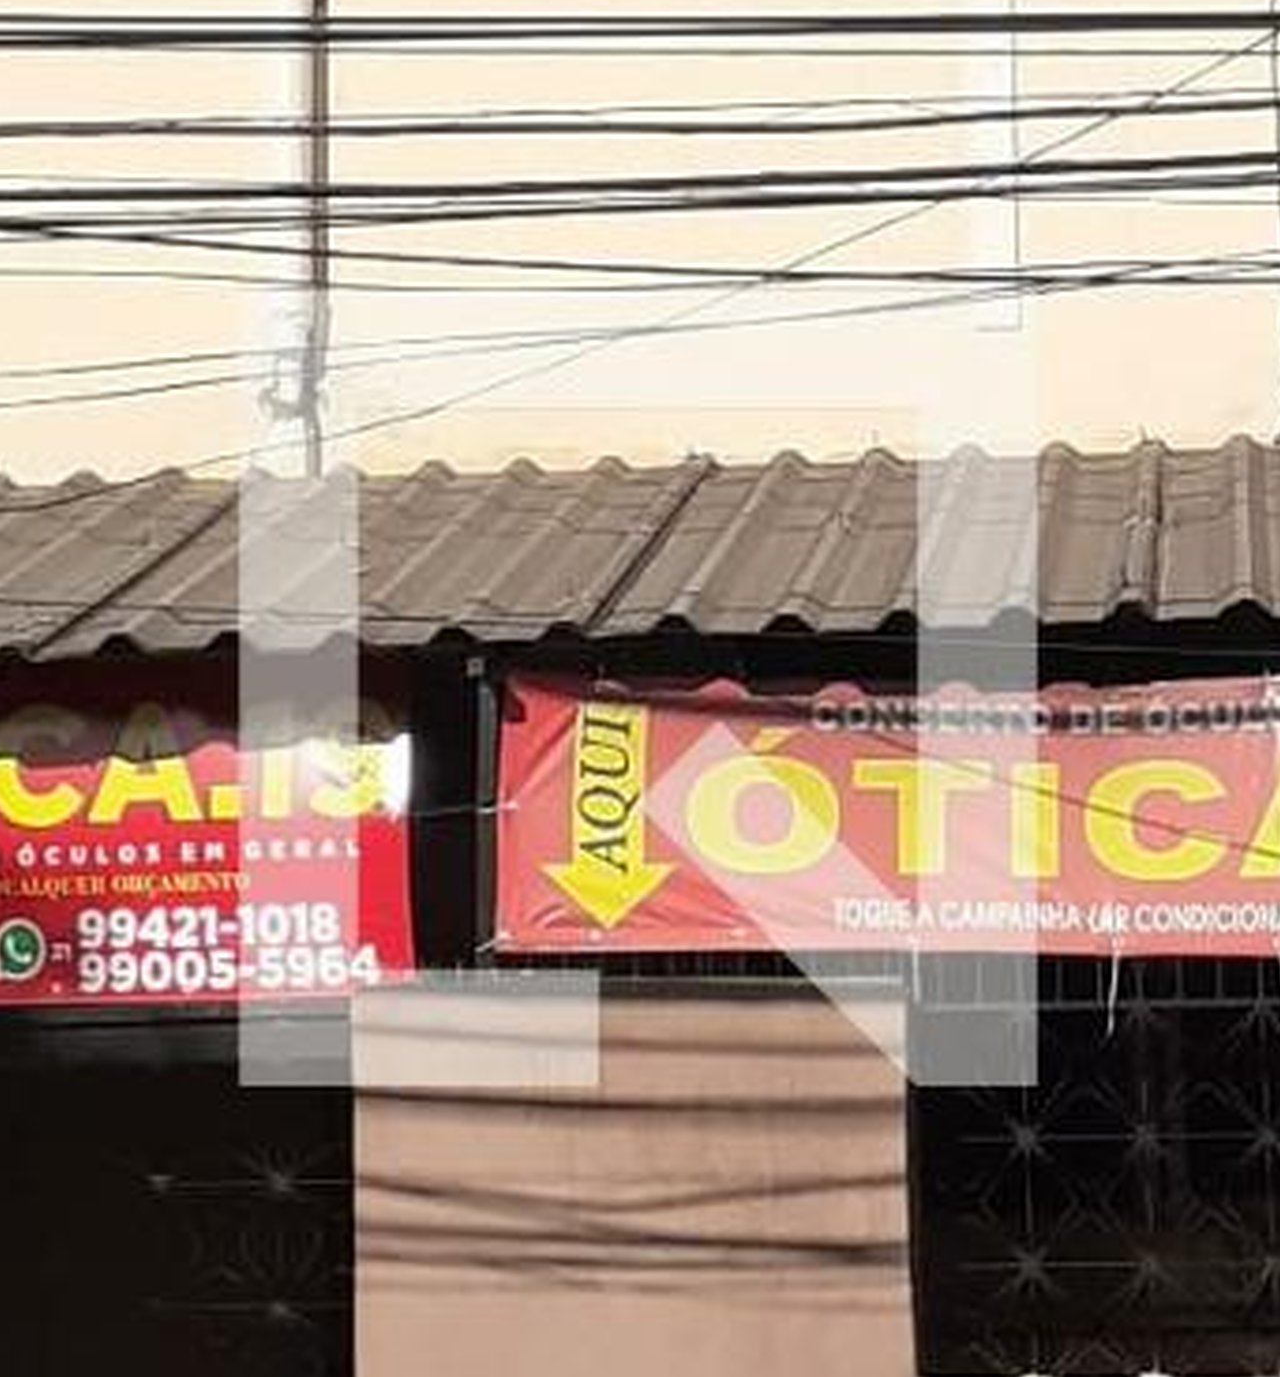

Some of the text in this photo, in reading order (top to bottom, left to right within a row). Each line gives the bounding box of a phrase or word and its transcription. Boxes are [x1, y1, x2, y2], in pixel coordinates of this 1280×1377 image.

[812, 700, 1050, 735] CONSERTO
[1069, 702, 1124, 735] DE
[577, 717, 637, 873] AQUI
[20, 839, 161, 868] ÓCULOS
[181, 842, 224, 862] EM
[243, 839, 362, 860] GERAL
[77, 903, 340, 948] 99421-1018
[833, 897, 912, 931] TOQUE
[916, 898, 933, 930] A
[940, 898, 1080, 931] CAMPAINHA
[1086, 898, 1129, 931] (AR
[77, 945, 382, 994] 99005-5964
